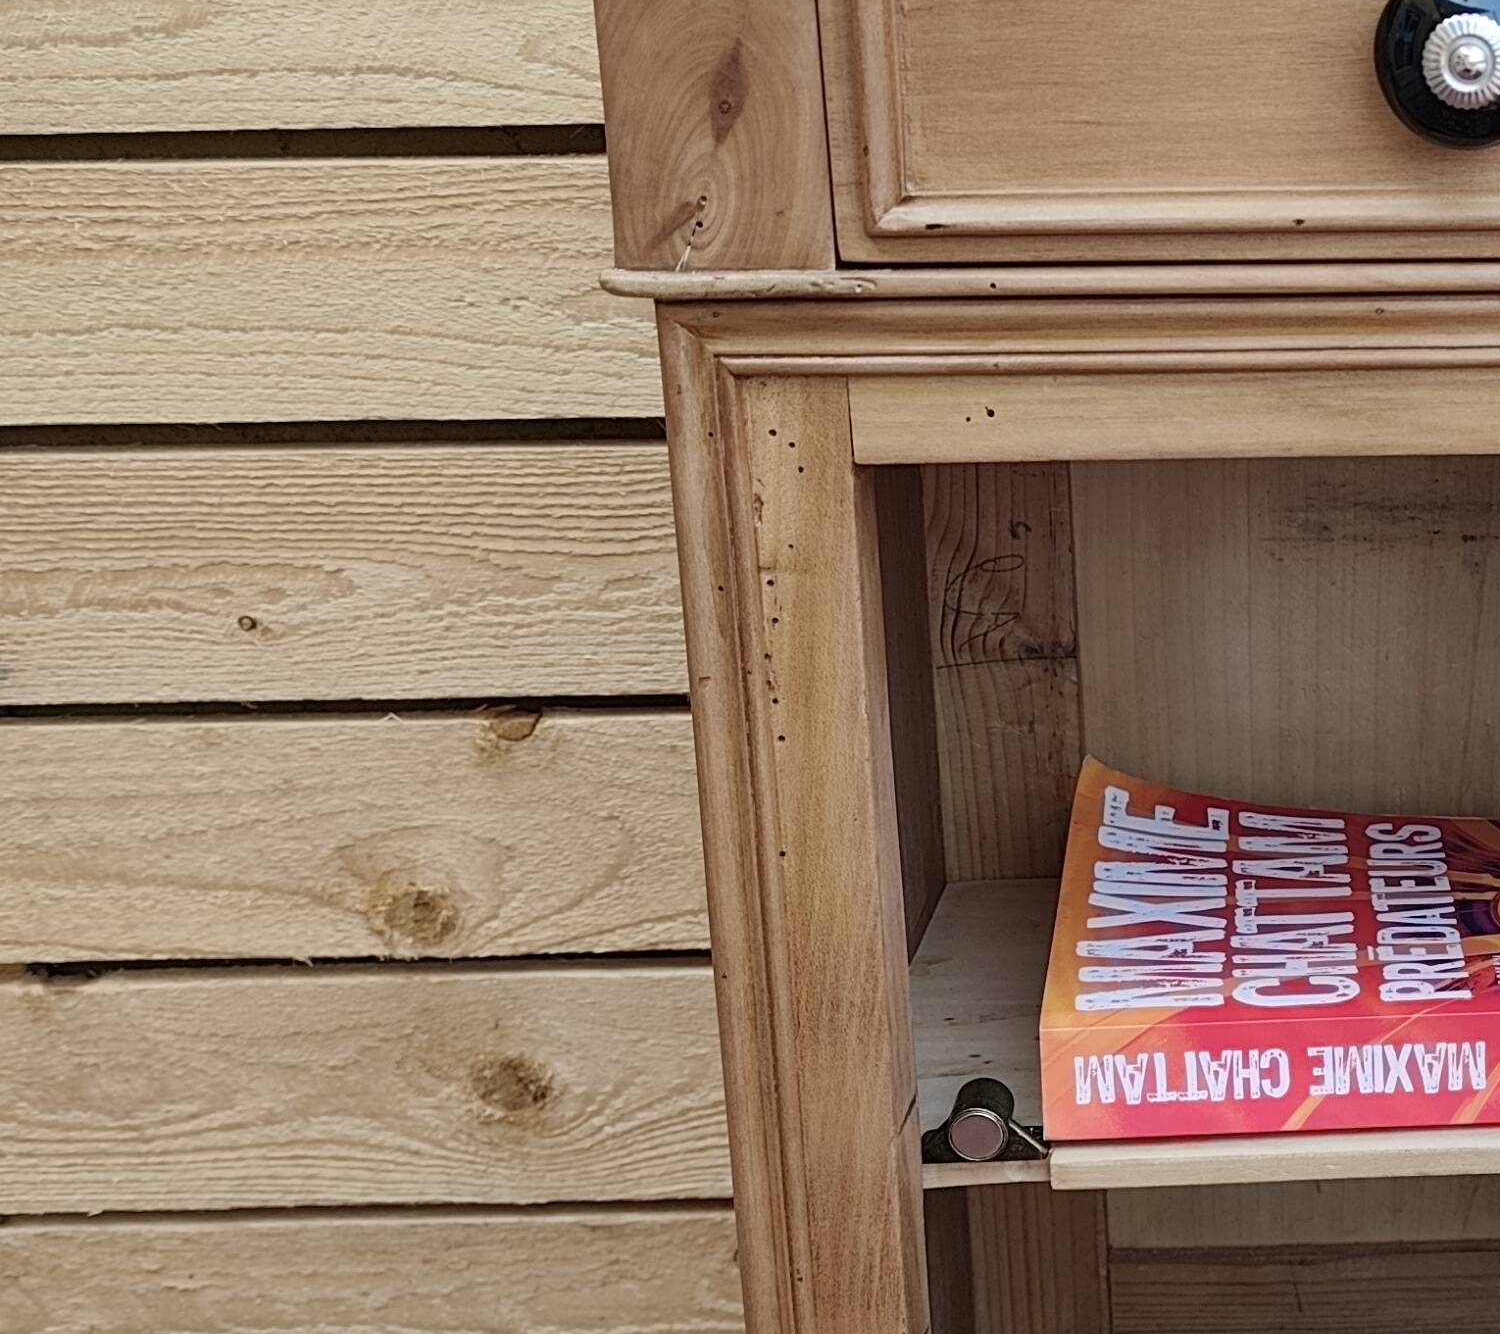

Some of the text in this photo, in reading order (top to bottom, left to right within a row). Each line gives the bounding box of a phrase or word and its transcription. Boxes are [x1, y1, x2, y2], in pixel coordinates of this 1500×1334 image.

[1075, 785, 1230, 1011] MAXIME
[1230, 811, 1361, 1008] CHATTAM
[1365, 822, 1475, 1002] PRÉDATEURS
[1074, 1041, 1488, 1105] MAXIME CHATTAM
